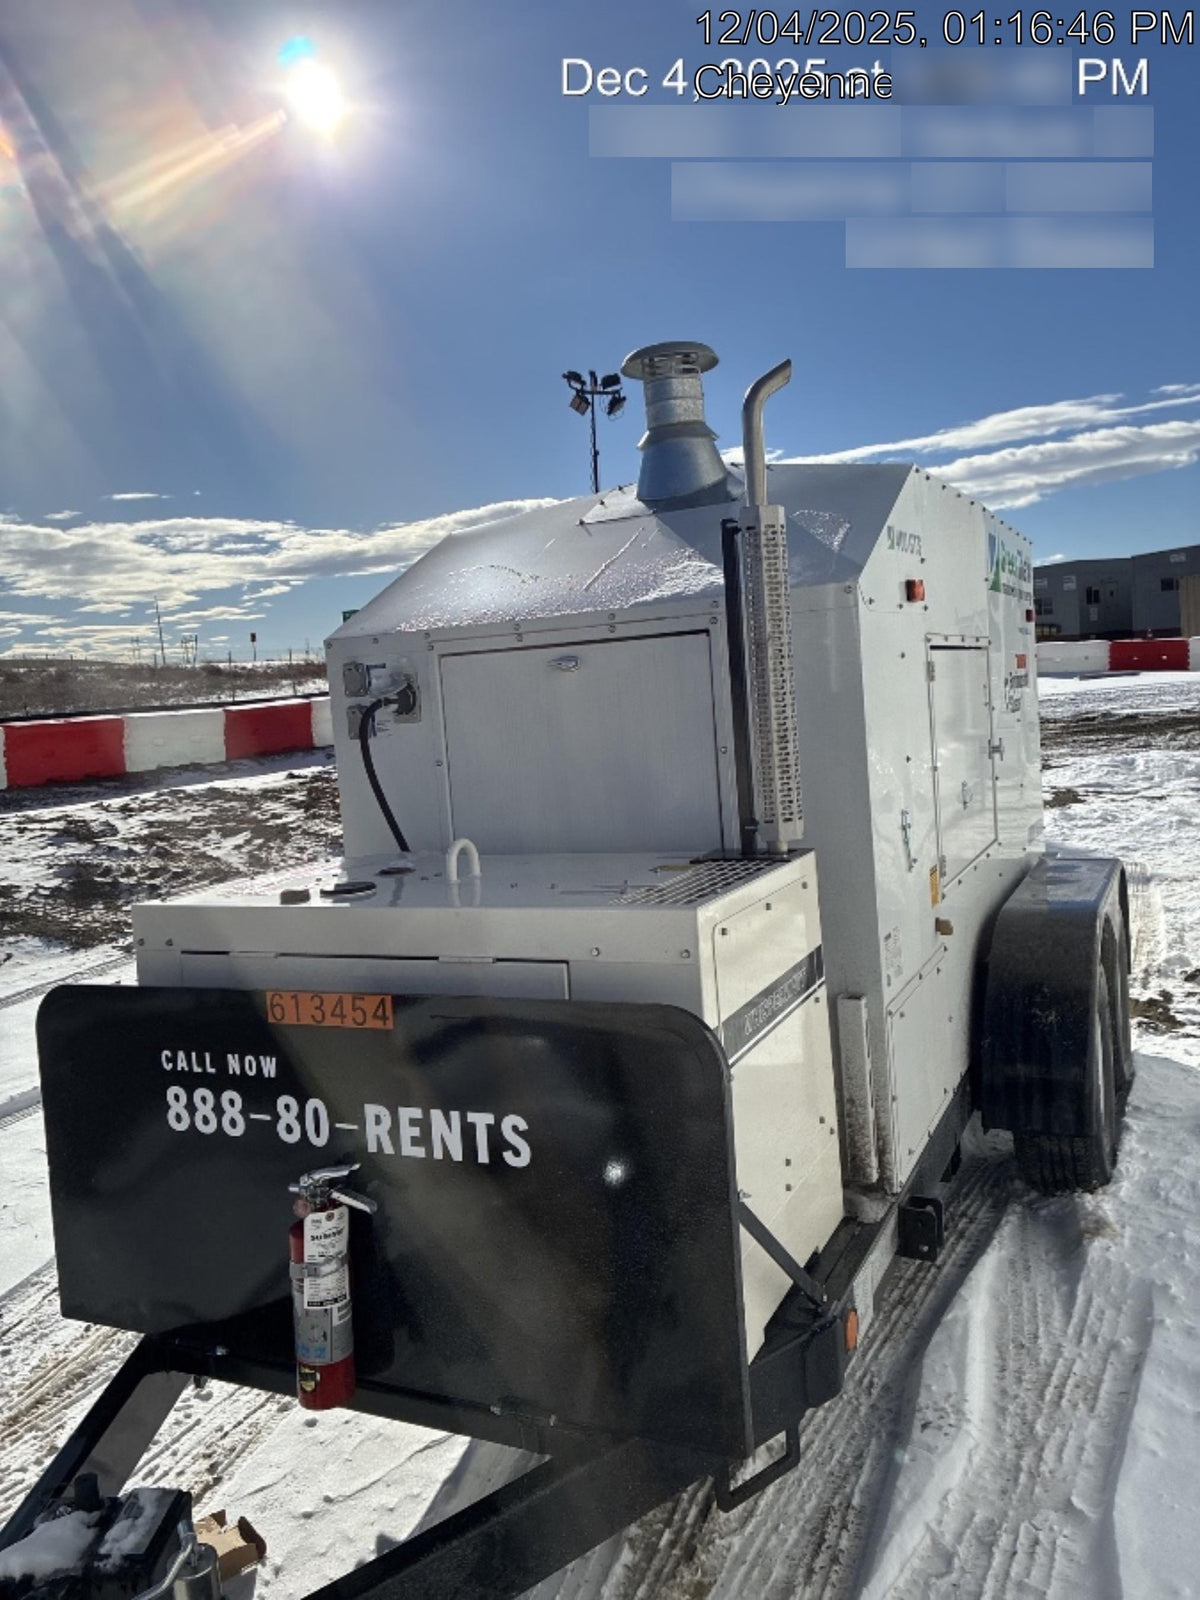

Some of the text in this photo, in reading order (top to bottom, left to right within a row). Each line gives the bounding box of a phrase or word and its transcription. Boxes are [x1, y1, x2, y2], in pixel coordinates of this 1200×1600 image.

[268, 992, 392, 1027] 613454
[160, 1048, 277, 1079] CALL NOW
[165, 1084, 532, 1169] 888-80-RENTS
